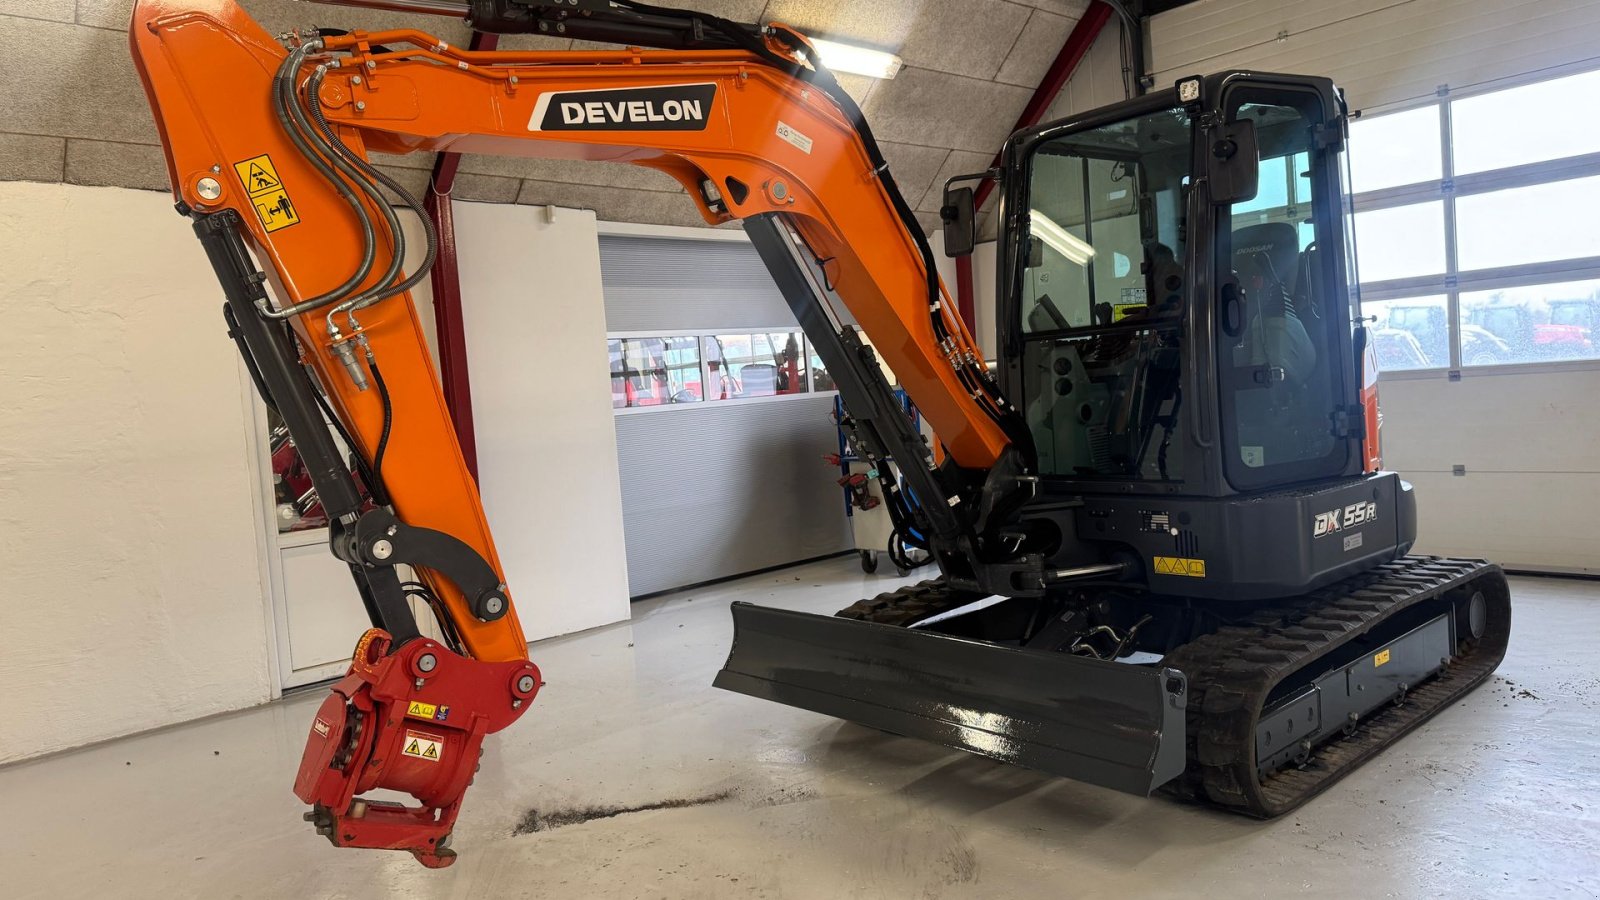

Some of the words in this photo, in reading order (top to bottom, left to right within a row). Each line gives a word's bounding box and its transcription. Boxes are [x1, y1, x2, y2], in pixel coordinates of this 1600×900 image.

[560, 99, 703, 125] DEVELON
[1314, 508, 1342, 539] DX
[1343, 501, 1377, 530] 55R
